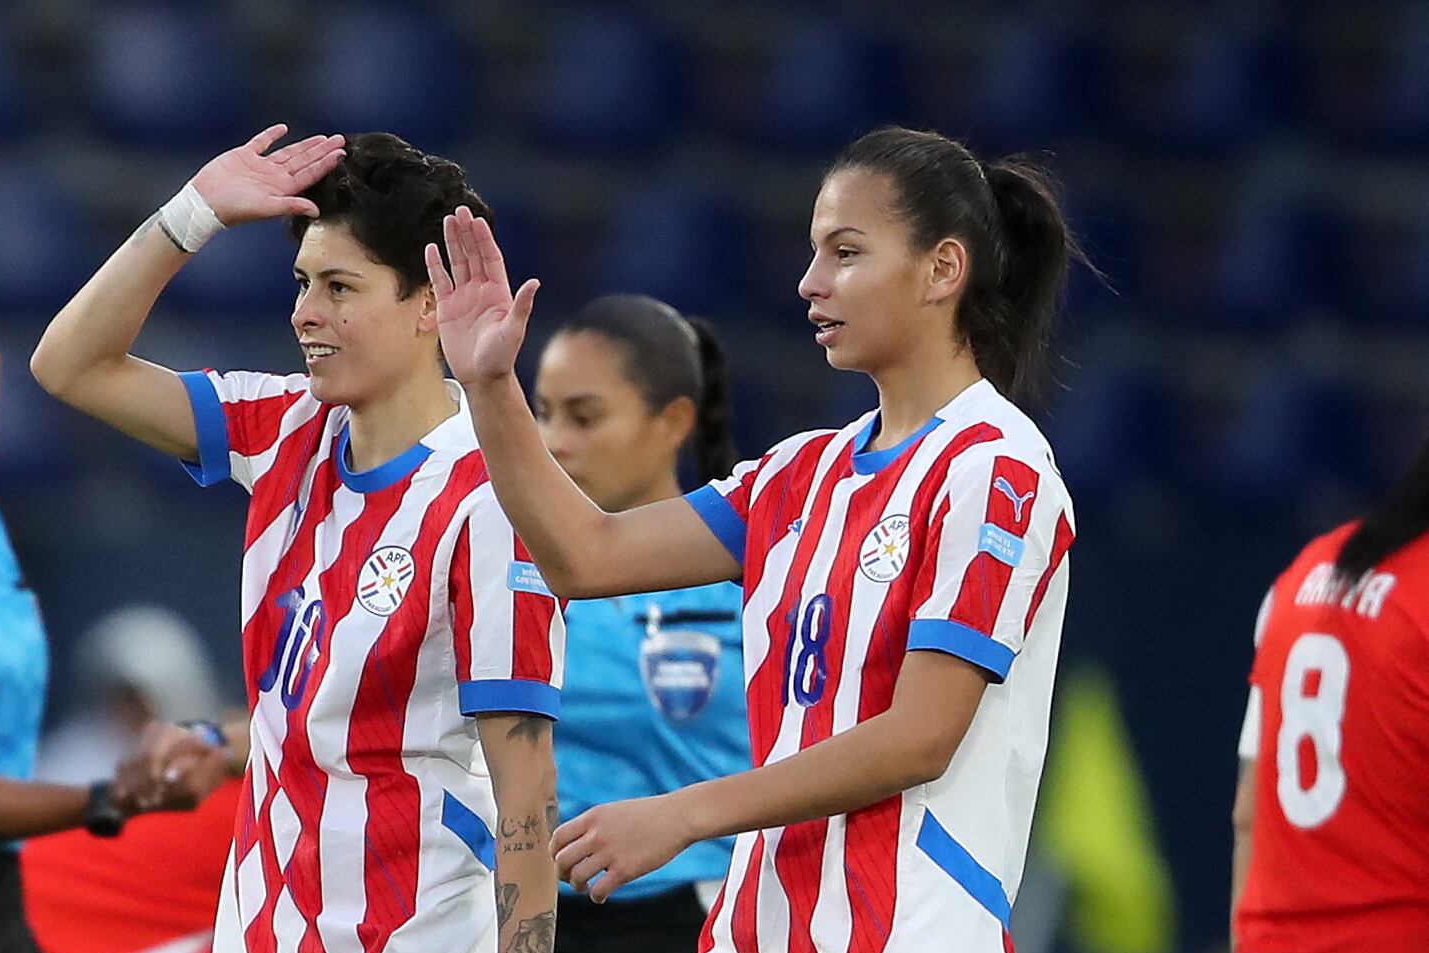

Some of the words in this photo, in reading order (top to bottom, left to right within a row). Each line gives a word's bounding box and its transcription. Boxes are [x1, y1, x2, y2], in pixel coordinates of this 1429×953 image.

[385, 551, 407, 564] APF
[781, 593, 832, 708] 18
[1277, 632, 1350, 829] 8
